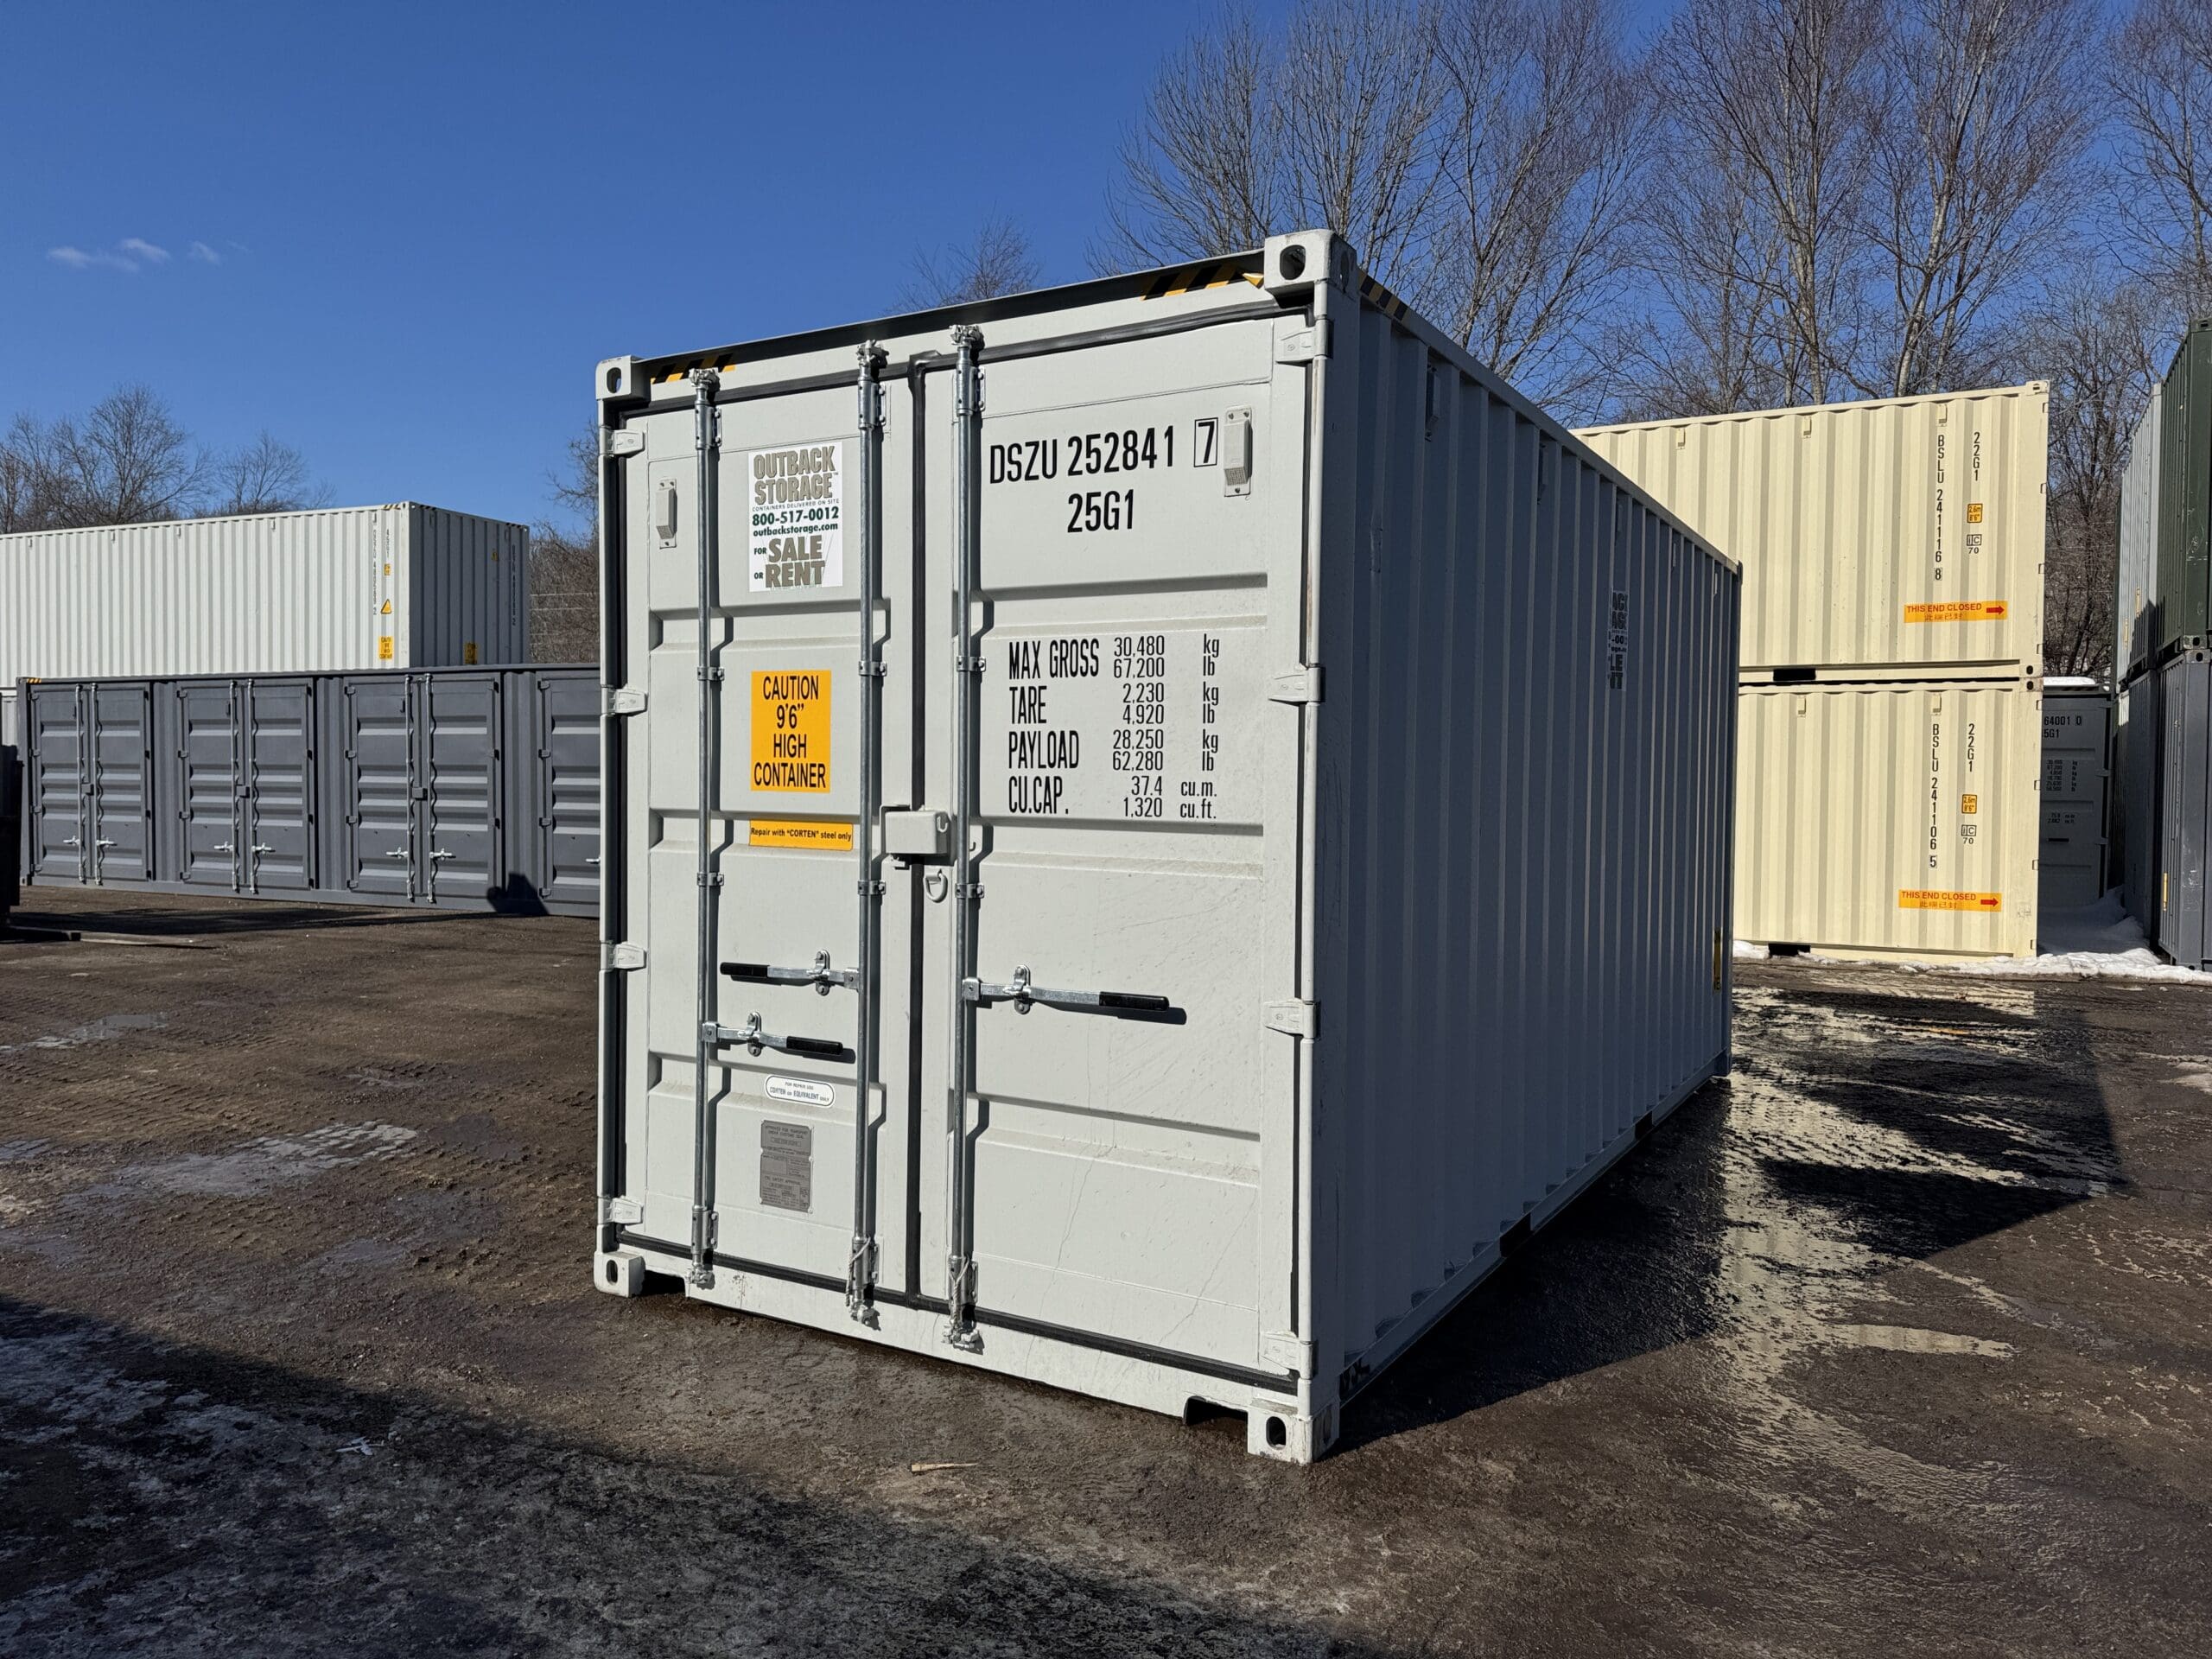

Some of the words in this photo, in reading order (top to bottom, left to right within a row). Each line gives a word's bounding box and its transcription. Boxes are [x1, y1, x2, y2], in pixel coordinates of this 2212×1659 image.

[753, 446, 836, 480] OUTBACK
[990, 438, 1058, 484] DSZU
[1068, 425, 1173, 476] 252841
[1198, 421, 1216, 465] 7
[754, 473, 833, 505] STORAGE
[753, 506, 839, 526] 800-517-0012
[1068, 489, 1134, 533] 25G1
[753, 523, 838, 537] outbackstorage.com
[754, 547, 766, 556] FOR
[769, 535, 823, 563] SALE
[766, 561, 825, 588] RENT
[1947, 602, 1981, 611] CLOSED
[1009, 640, 1041, 680] MAX
[1049, 638, 1100, 678] GROSS
[1114, 635, 1165, 658] 30,480
[1203, 633, 1220, 658] kg
[1114, 658, 1165, 678] 67,200
[1203, 656, 1215, 677] lb
[763, 675, 819, 700] CAUTION
[1009, 685, 1047, 724] TARE
[1123, 683, 1165, 703] 2,230
[1203, 681, 1219, 706] kg
[1123, 704, 1164, 725] 4,920
[1202, 703, 1215, 724] lb
[777, 703, 804, 729] 9'6"
[2044, 715, 2070, 725] 64001
[2044, 728, 2059, 738] 5G1
[773, 734, 807, 759] HIGH
[1008, 730, 1079, 769] PAYLOAD
[1113, 728, 1164, 750] 28,250
[1202, 728, 1218, 753] kg
[1112, 750, 1163, 771] 62,280
[1202, 751, 1214, 771] lb
[753, 762, 826, 788] CONTAINER
[1131, 775, 1162, 796] 37.4
[1180, 780, 1217, 797] cu.m.
[1123, 797, 1162, 817] 1,320
[1179, 798, 1217, 818] cu.ft.
[750, 827, 770, 837] Repair
[786, 830, 819, 838] "CORTEN"
[837, 832, 852, 842] only
[793, 1090, 819, 1100] EQUIVALENT
